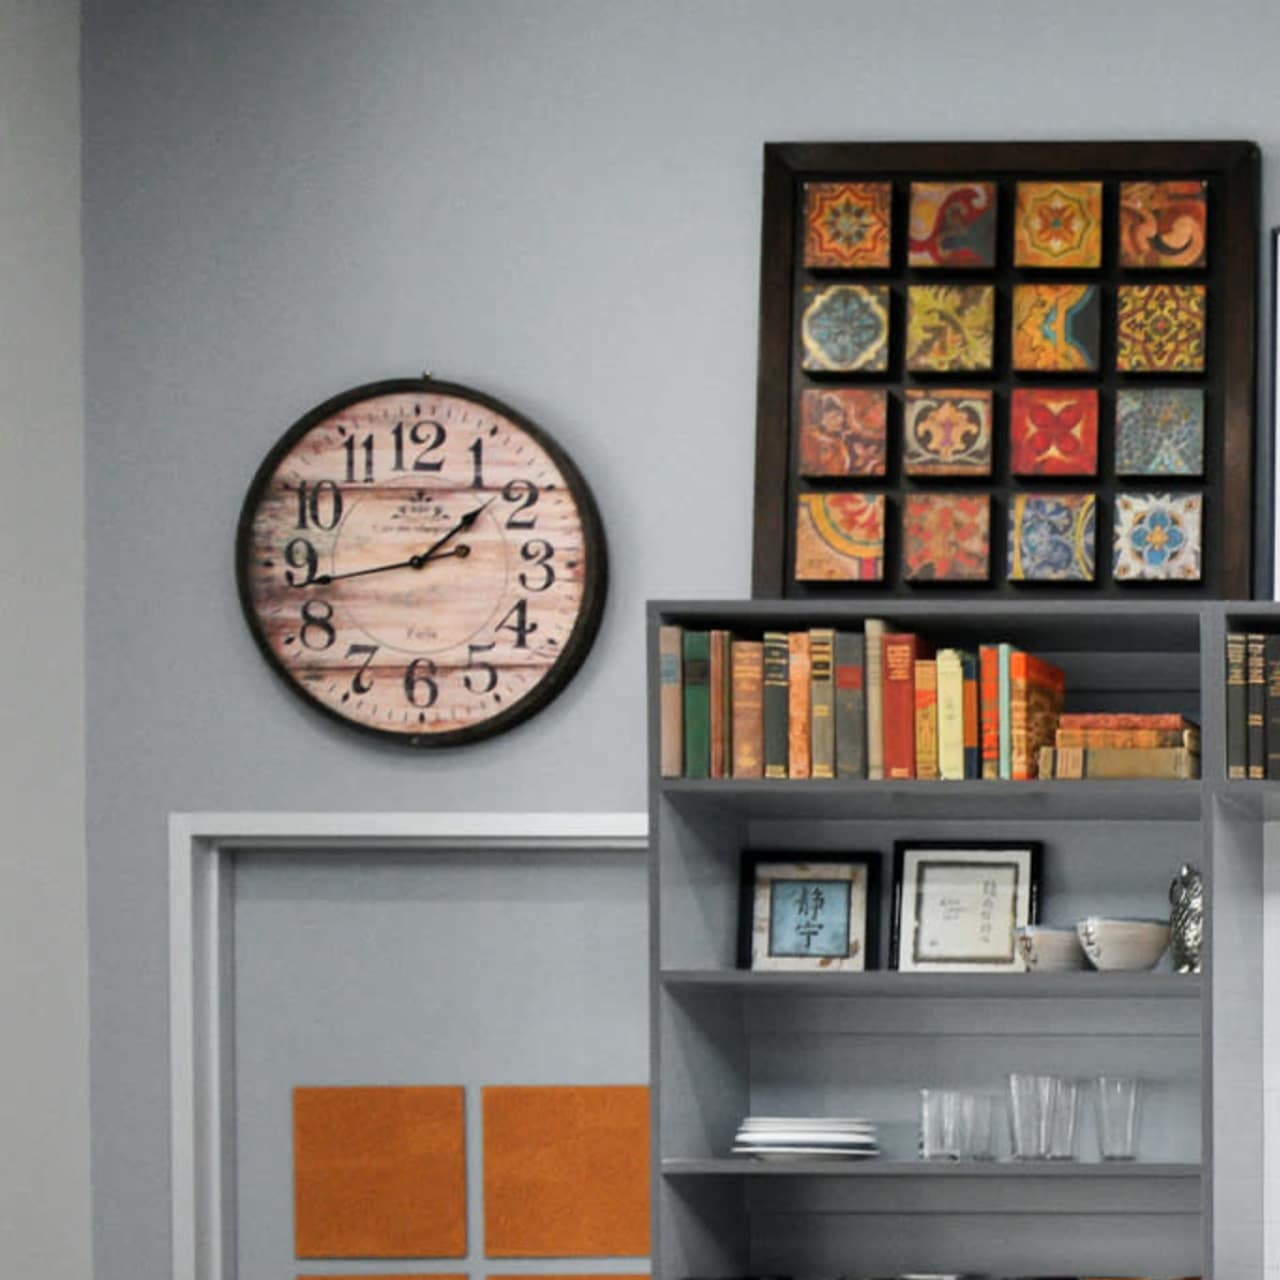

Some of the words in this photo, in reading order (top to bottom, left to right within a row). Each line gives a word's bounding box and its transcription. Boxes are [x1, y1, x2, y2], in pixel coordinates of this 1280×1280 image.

[343, 434, 375, 484] 11
[391, 420, 447, 473] 12
[469, 436, 485, 489] 1
[297, 479, 343, 531] 10
[503, 479, 540, 530] 2
[284, 538, 320, 588] 9
[519, 539, 556, 593] 3
[299, 600, 337, 650] 8
[496, 599, 538, 649] 4
[345, 643, 379, 695] 7
[404, 657, 439, 709] 6
[463, 641, 498, 694] 5
